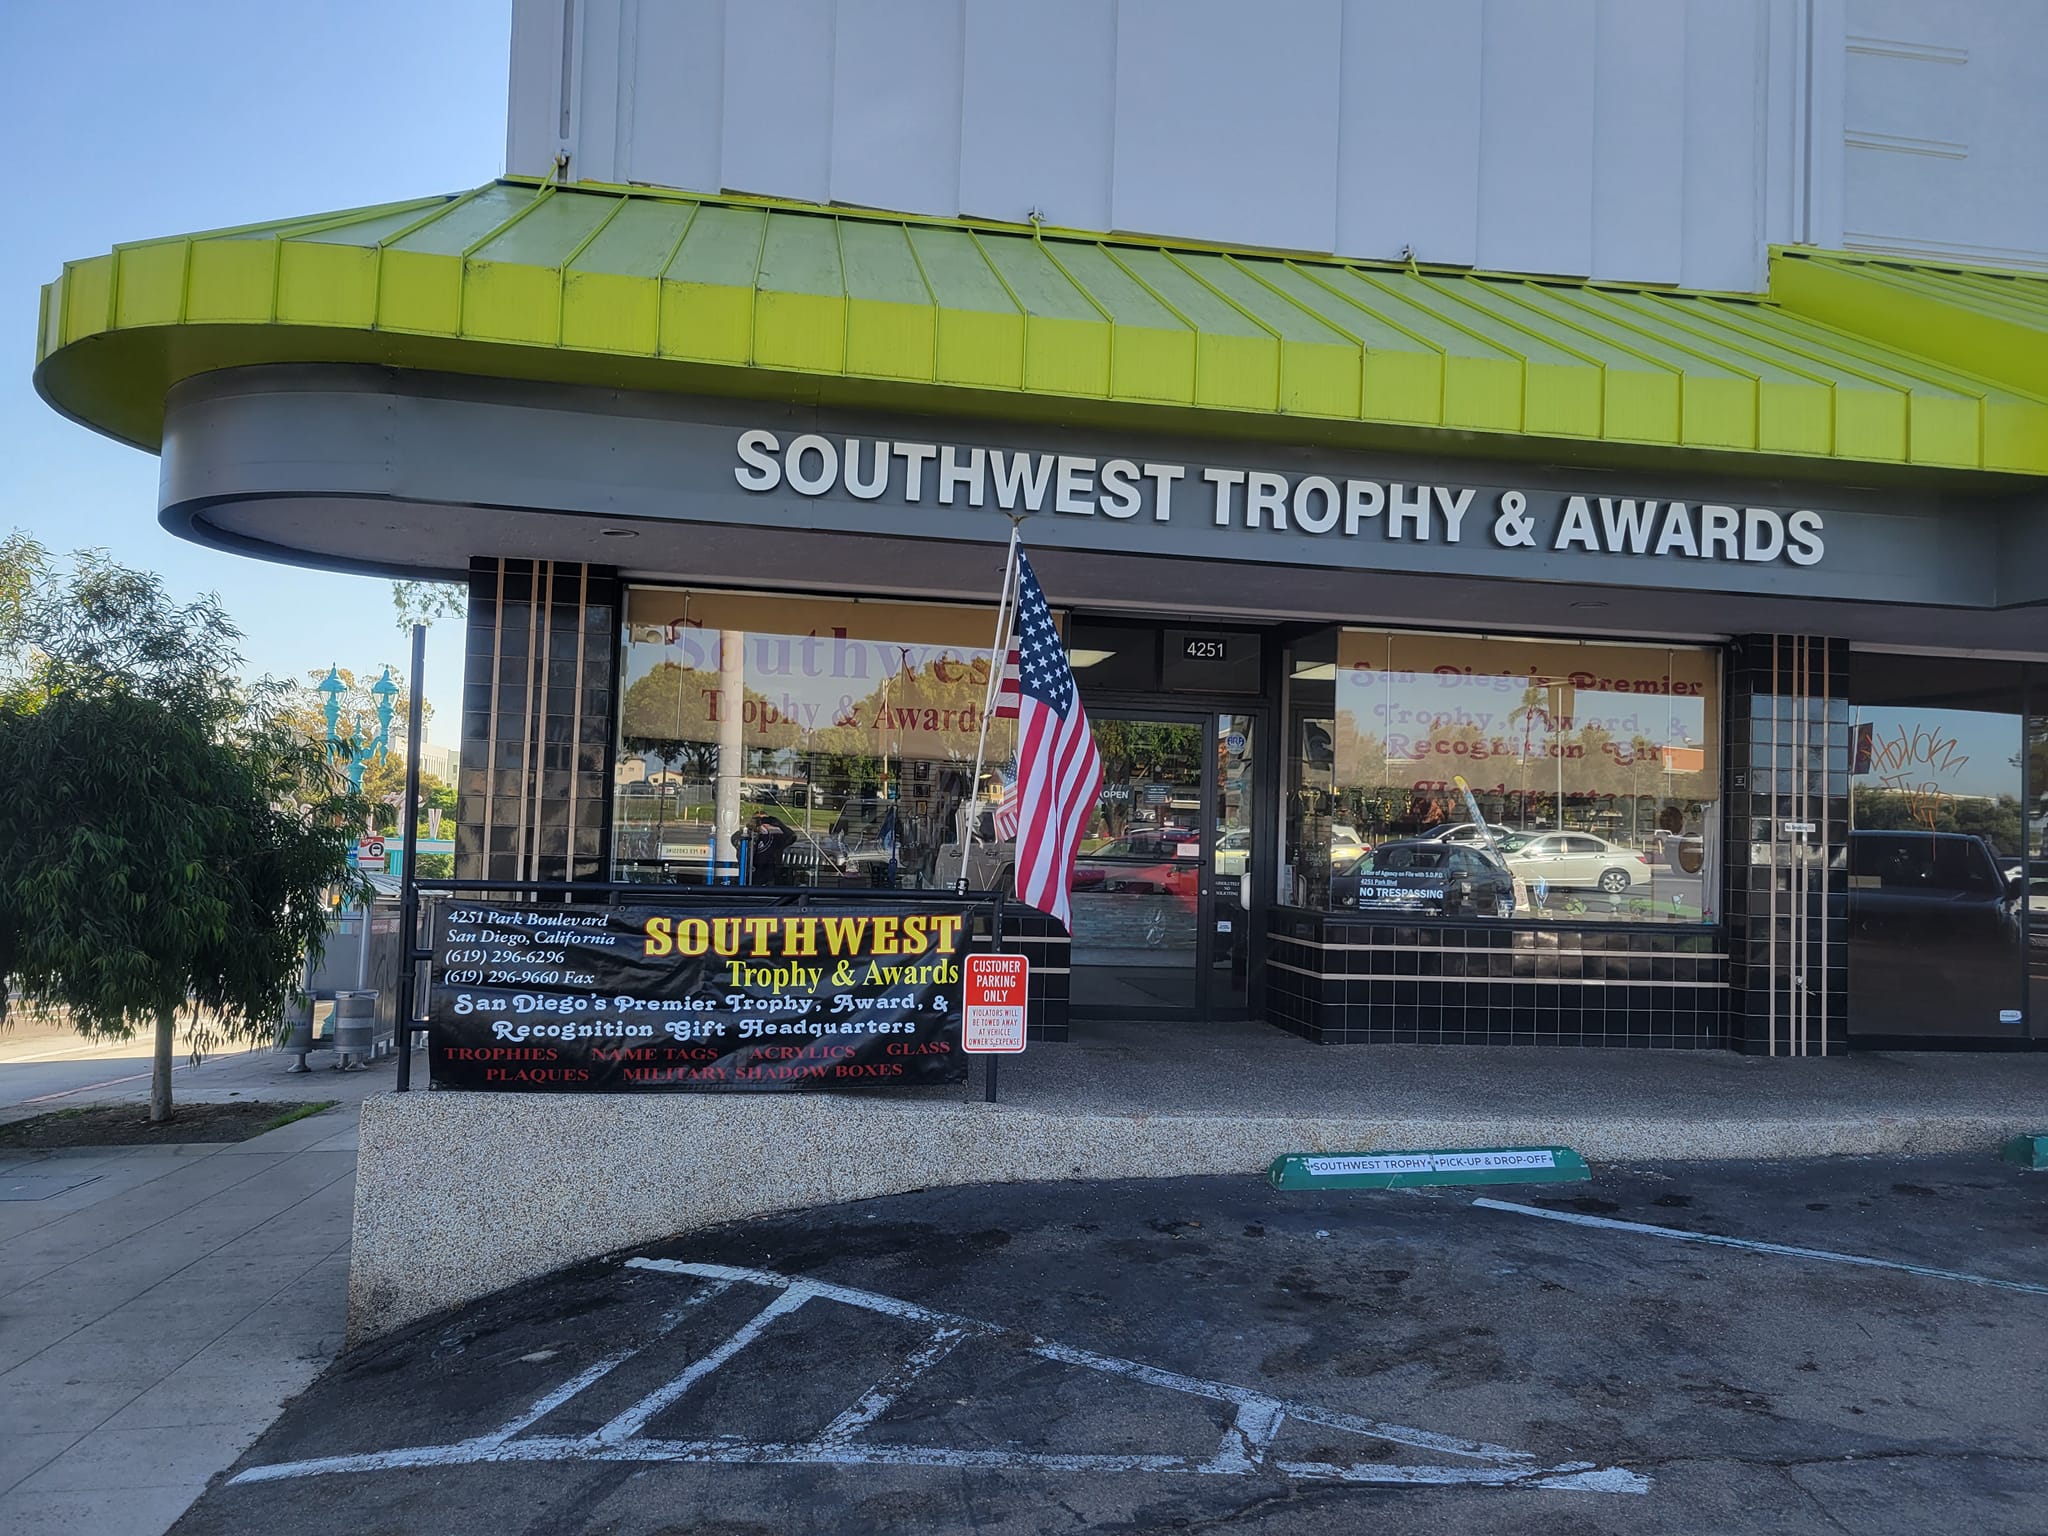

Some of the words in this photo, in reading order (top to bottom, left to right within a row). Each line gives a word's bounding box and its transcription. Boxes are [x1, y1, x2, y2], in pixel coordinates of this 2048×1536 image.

[734, 429, 1185, 521] SOUTHWEST
[1204, 467, 1476, 543] TROPHY
[1496, 490, 1536, 547] &
[1554, 496, 1825, 566] AWARDS
[1187, 642, 1225, 658] 4251
[1350, 661, 1417, 688] San
[1432, 663, 1551, 692] Diego's
[1568, 671, 1703, 695] Premier
[831, 694, 862, 728] &
[871, 701, 991, 733] Awards
[1372, 703, 1507, 731] Trophy,
[1383, 732, 1587, 760] Recognition
[1103, 790, 1129, 799] OPEN
[1360, 888, 1374, 897] NO
[1376, 888, 1444, 899] TRESPASSING
[448, 911, 483, 925] 4251
[486, 911, 523, 925] Park
[527, 912, 609, 927] Boulevard
[447, 929, 477, 943] San
[480, 930, 530, 947] Diego,
[534, 930, 616, 948] California
[644, 915, 963, 956] SOUTHWEST
[445, 949, 487, 966] (619)
[491, 950, 565, 964] 296-6296
[973, 959, 1021, 973] CUSTOMER
[444, 969, 484, 986] (619)
[488, 970, 560, 985] 296-9660
[564, 970, 595, 984] Fax
[726, 958, 823, 994] Trophy
[831, 958, 856, 987] &
[863, 958, 959, 985] Awards
[976, 975, 1016, 988] PARKING
[454, 993, 507, 1015] San
[512, 993, 607, 1015] Diego's
[613, 994, 716, 1014] Premier
[725, 993, 822, 1014] Trophy,
[830, 993, 923, 1013] Award,
[932, 995, 949, 1012] &
[983, 990, 1008, 1003] ONLY
[972, 1009, 1003, 1017] VIOLATORS
[1004, 1009, 1018, 1017] WILL
[491, 1019, 655, 1043] Recognition
[664, 1020, 726, 1041] Gift
[738, 1018, 916, 1039] Headquarters
[972, 1018, 980, 1027] BE
[981, 1018, 1000, 1027] TOWED
[1002, 1018, 1018, 1027] AWAY
[978, 1028, 986, 1036] AT
[987, 1028, 1011, 1036] VEHICLE
[969, 1038, 993, 1046] OWNER'S
[995, 1038, 1020, 1047] EXPENSE
[444, 1047, 558, 1062] TROPHIES
[591, 1047, 657, 1061] NAME
[663, 1047, 719, 1061] TAGS
[750, 1045, 856, 1060] ACRYLICS
[886, 1041, 951, 1057] GLASS
[485, 1067, 590, 1084] PLAQUES
[622, 1066, 729, 1081] MILITARY
[735, 1065, 829, 1080] SHADOW
[836, 1063, 903, 1079] BOXES
[1313, 1160, 1381, 1171] SOUTHWEST
[1383, 1159, 1427, 1169] TROPHY
[1439, 1157, 1482, 1168] PICK-UP
[1484, 1156, 1492, 1165] &
[1494, 1154, 1547, 1165] DROP-OFF
